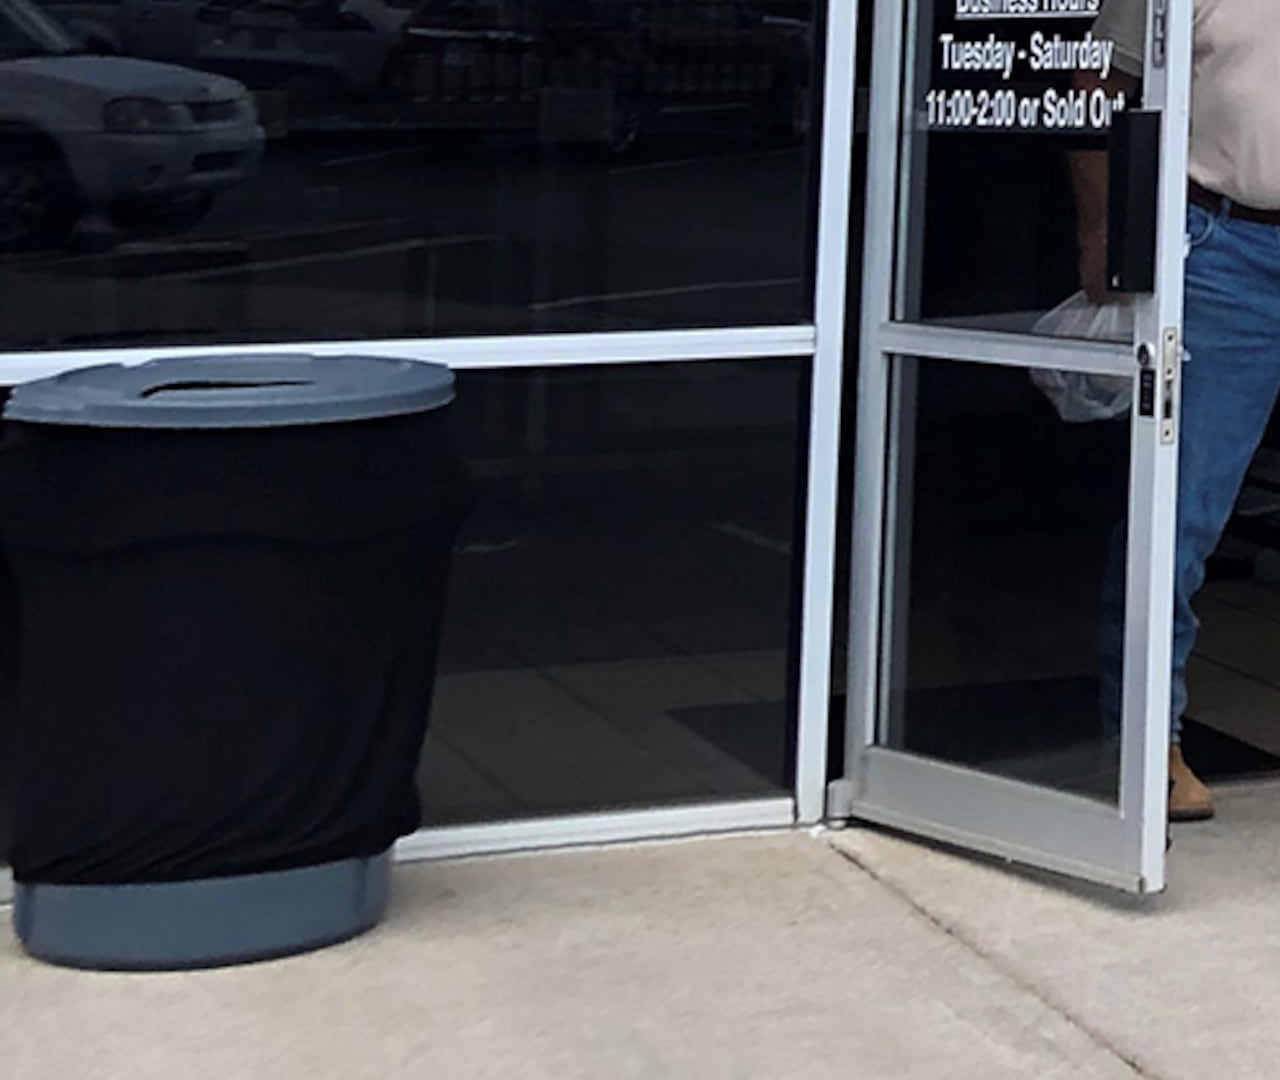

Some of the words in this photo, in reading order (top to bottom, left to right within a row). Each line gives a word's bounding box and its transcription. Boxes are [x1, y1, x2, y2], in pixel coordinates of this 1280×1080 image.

[939, 33, 1016, 80] Tuesday
[1017, 50, 1027, 60] -
[1030, 31, 1114, 80] Saturday
[926, 89, 1016, 127] 11:00-2:00
[1018, 97, 1040, 128] or
[1043, 87, 1085, 128] Sold
